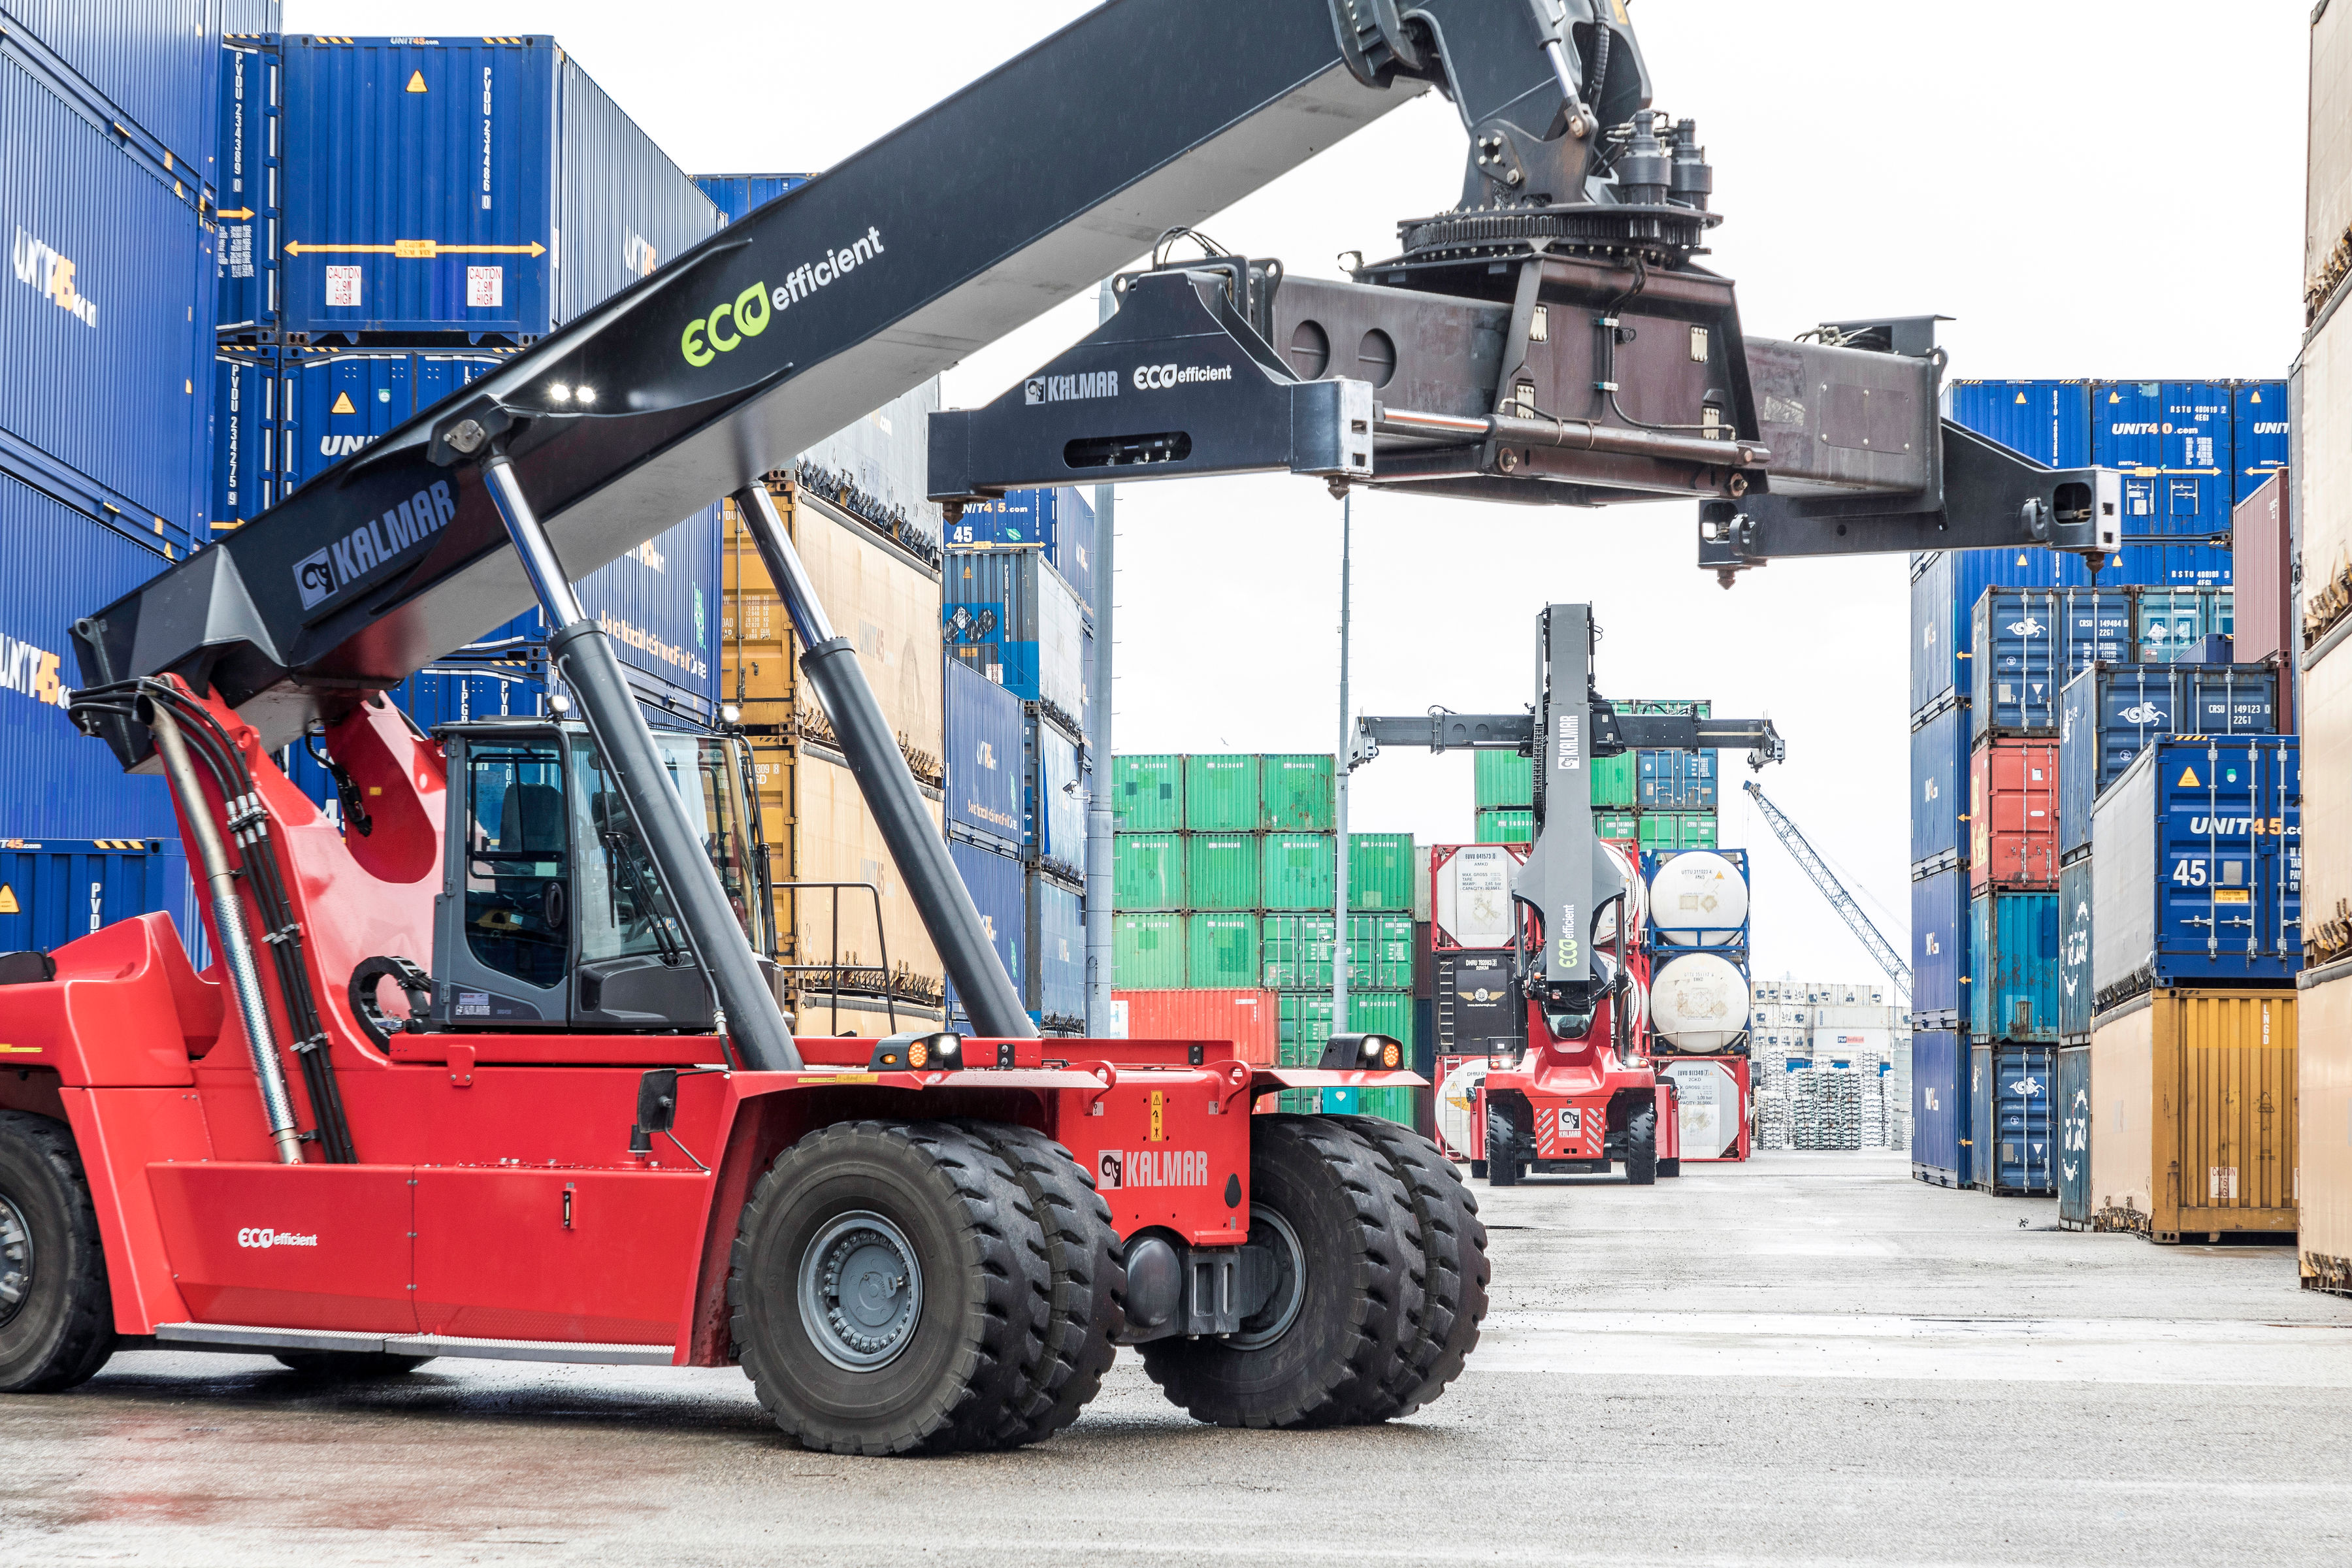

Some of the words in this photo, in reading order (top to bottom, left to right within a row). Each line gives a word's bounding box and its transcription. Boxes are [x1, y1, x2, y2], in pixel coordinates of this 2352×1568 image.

[235, 52, 243, 99] PVDU
[329, 268, 360, 279] CAUTION
[470, 269, 501, 280] CAUTION
[772, 226, 885, 310] efficient
[335, 281, 351, 292] 2.9M
[476, 282, 493, 293] 2.9M
[335, 293, 351, 304] HIGH
[476, 294, 493, 305] HIGH
[231, 365, 239, 412] PVDU
[1048, 370, 1118, 402] KALMAR
[1177, 365, 1232, 383] efficient
[229, 416, 238, 487] 234275
[320, 435, 380, 455] UN
[962, 502, 1028, 514] NIT45.com
[331, 480, 455, 585] KALMAR
[953, 527, 973, 543] 45
[2209, 705, 2225, 713] CRSU
[2234, 705, 2261, 713] 149123
[2233, 715, 2251, 724] 22G1
[1560, 715, 1578, 756] KALMAR
[0, 839, 42, 849] T45.com
[2173, 860, 2206, 886] 45
[90, 883, 101, 934] PVD
[1562, 904, 1574, 939] efficient
[1126, 1151, 1207, 1186] KALMAR
[273, 1233, 318, 1247] efficient
